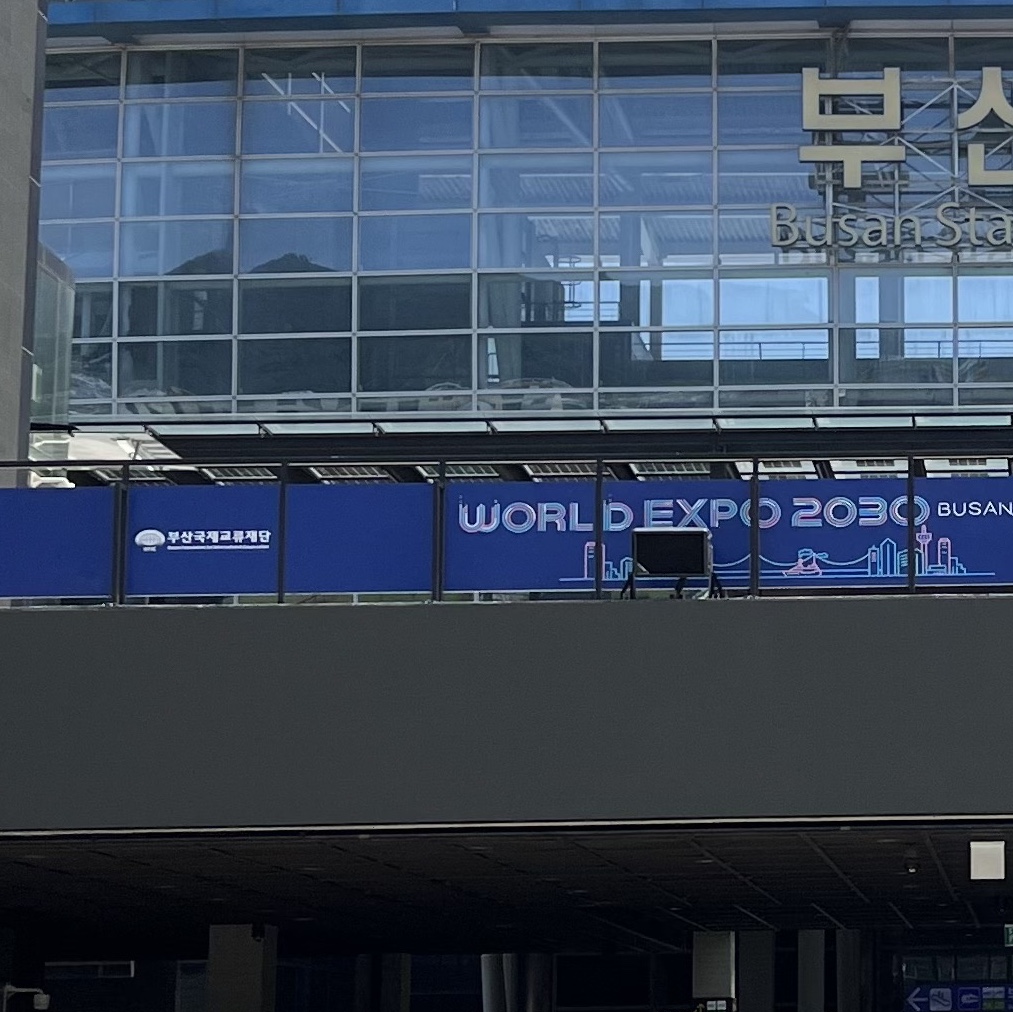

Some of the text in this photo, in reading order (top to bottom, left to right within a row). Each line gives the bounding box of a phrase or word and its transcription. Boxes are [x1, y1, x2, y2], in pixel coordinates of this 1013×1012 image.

[769, 203, 922, 247] Busan
[458, 494, 633, 534] WORLD
[643, 498, 782, 529] EXPO
[791, 496, 931, 529] 2030
